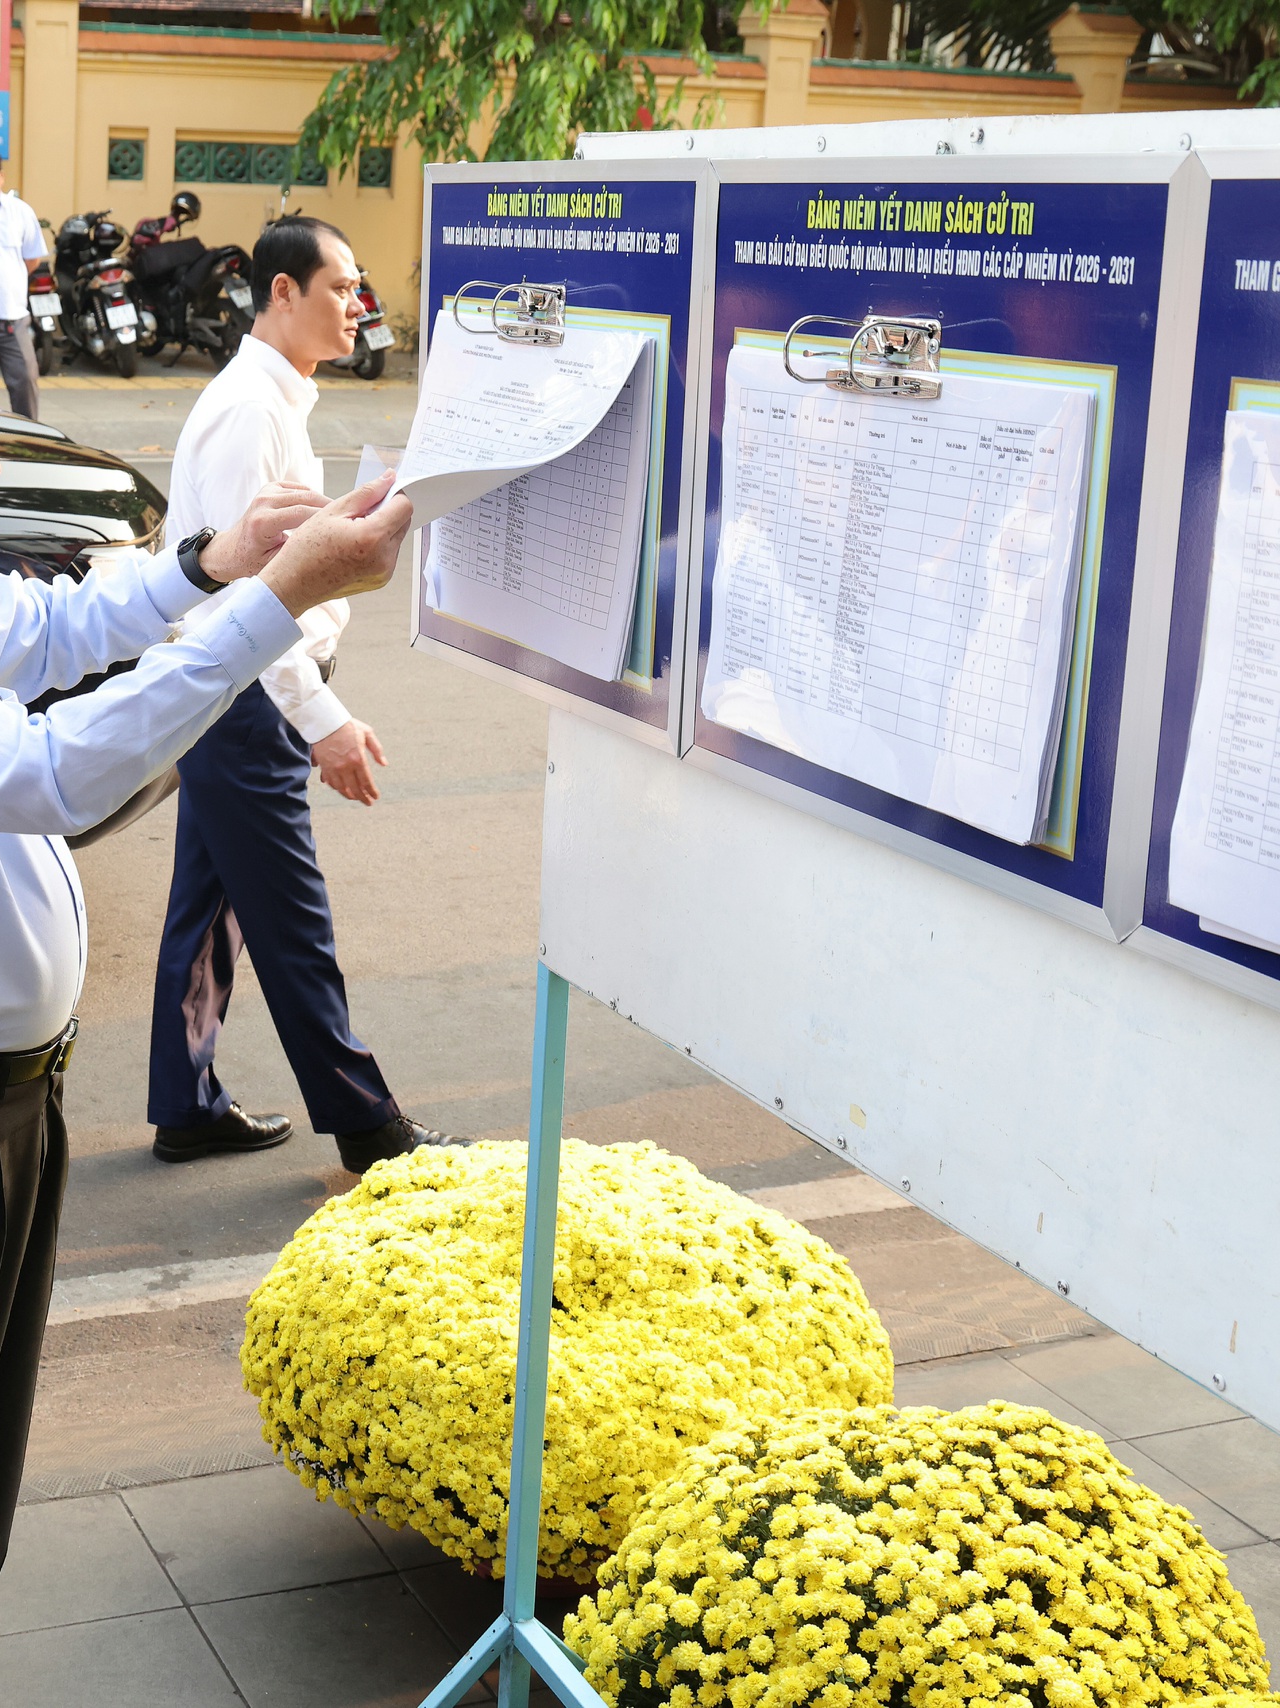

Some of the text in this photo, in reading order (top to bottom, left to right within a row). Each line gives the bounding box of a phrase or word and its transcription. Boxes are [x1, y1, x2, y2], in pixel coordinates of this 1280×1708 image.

[487, 184, 622, 219] BẢNG NIÊM YẾT DANH SÁCH CỬ TRI
[807, 189, 1035, 236] BẢNG NIÊM YẾT DANH SÁCH CỬ TRI
[592, 226, 603, 252] CÁC
[604, 223, 616, 252] CẤP
[616, 226, 636, 257] NHIỆM
[636, 227, 645, 253] KỲ
[645, 232, 660, 254] 2026
[664, 232, 679, 255] 2031
[734, 240, 754, 264] THAM
[755, 241, 767, 265] GIA
[784, 235, 796, 267] CỬ
[795, 243, 809, 272] ĐẠI
[810, 234, 827, 269] BIỂU
[828, 236, 850, 272] QUỐC
[850, 240, 864, 276] HỘI
[865, 241, 887, 273] KHÓA
[888, 246, 903, 273] XVI
[904, 242, 915, 273] VÀ
[916, 247, 932, 279] ĐẠI
[933, 238, 954, 275] BIỂU
[955, 249, 981, 277] HĐND
[982, 245, 1002, 279] CÁC
[1003, 241, 1023, 279] CẤP
[1024, 247, 1058, 286] NHIỆM
[1058, 247, 1073, 282] KỲ
[1073, 254, 1101, 284] 2026
[1108, 255, 1135, 286] 2031
[1235, 259, 1270, 292] THAM
